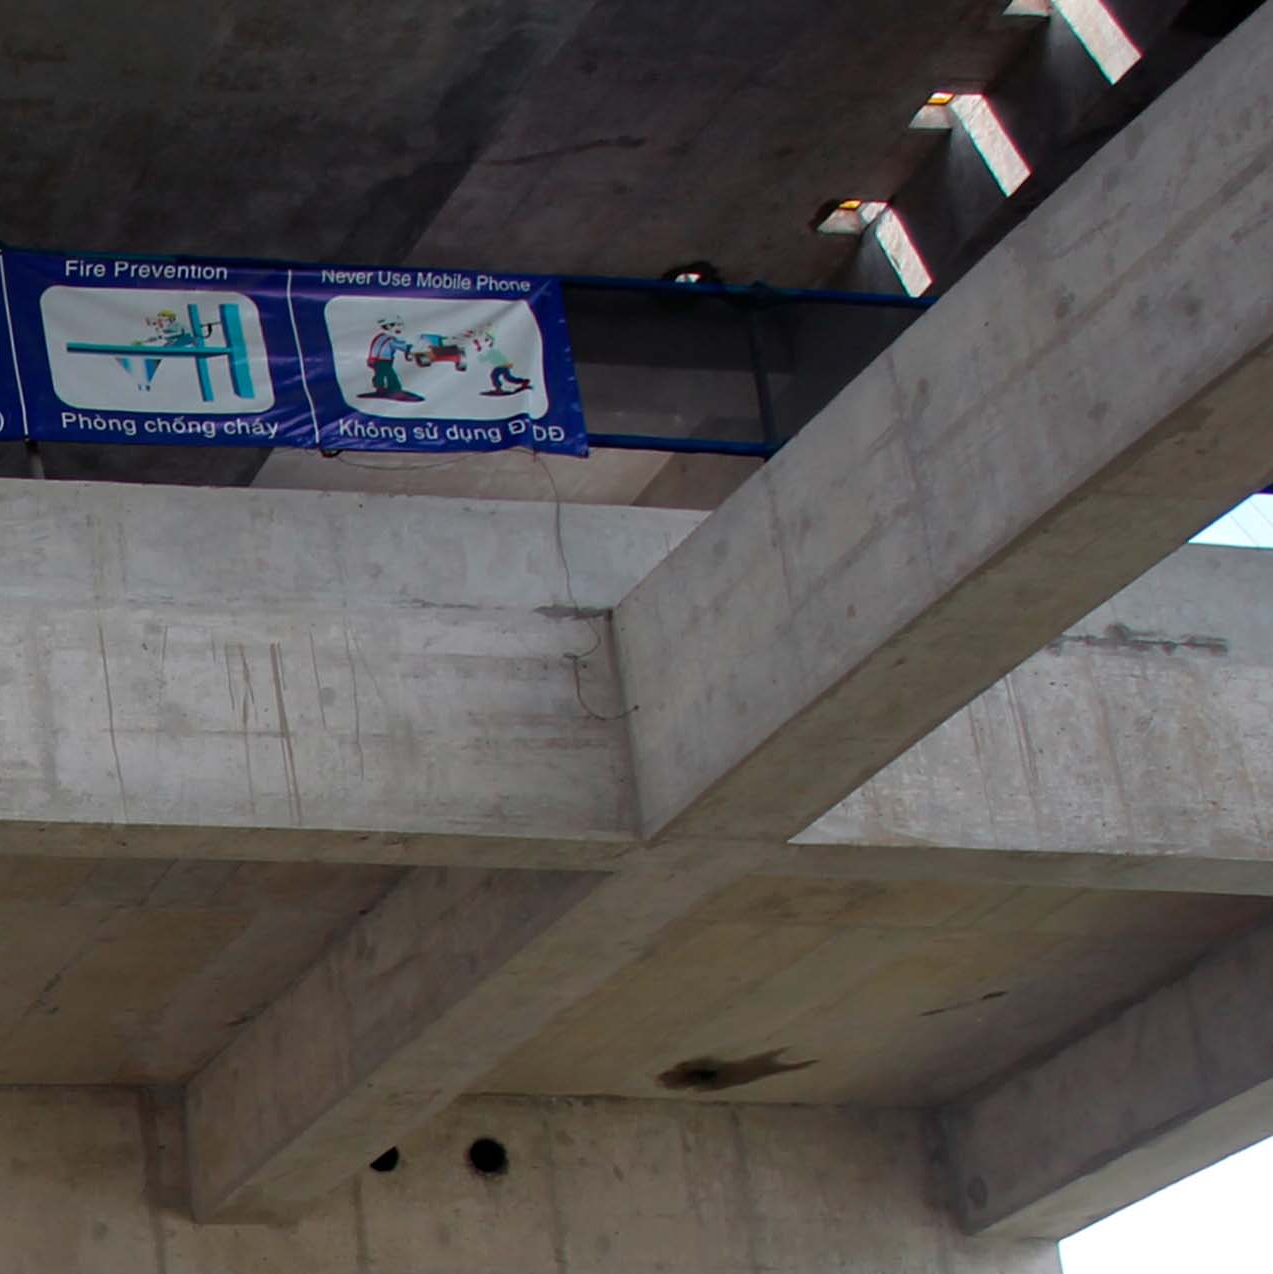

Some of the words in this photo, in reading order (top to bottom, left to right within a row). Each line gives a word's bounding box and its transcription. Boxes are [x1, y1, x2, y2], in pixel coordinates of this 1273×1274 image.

[64, 260, 106, 277] Fire
[114, 261, 228, 280] Prevention
[321, 270, 373, 285] Never
[378, 271, 411, 287] Use
[416, 272, 471, 290] Mobile
[476, 275, 531, 292] Phone
[61, 411, 137, 435] Phòng
[144, 416, 217, 438] chống
[223, 417, 279, 439] cháy
[338, 419, 407, 442] Không
[413, 421, 438, 440] sử
[446, 424, 502, 444] dụng
